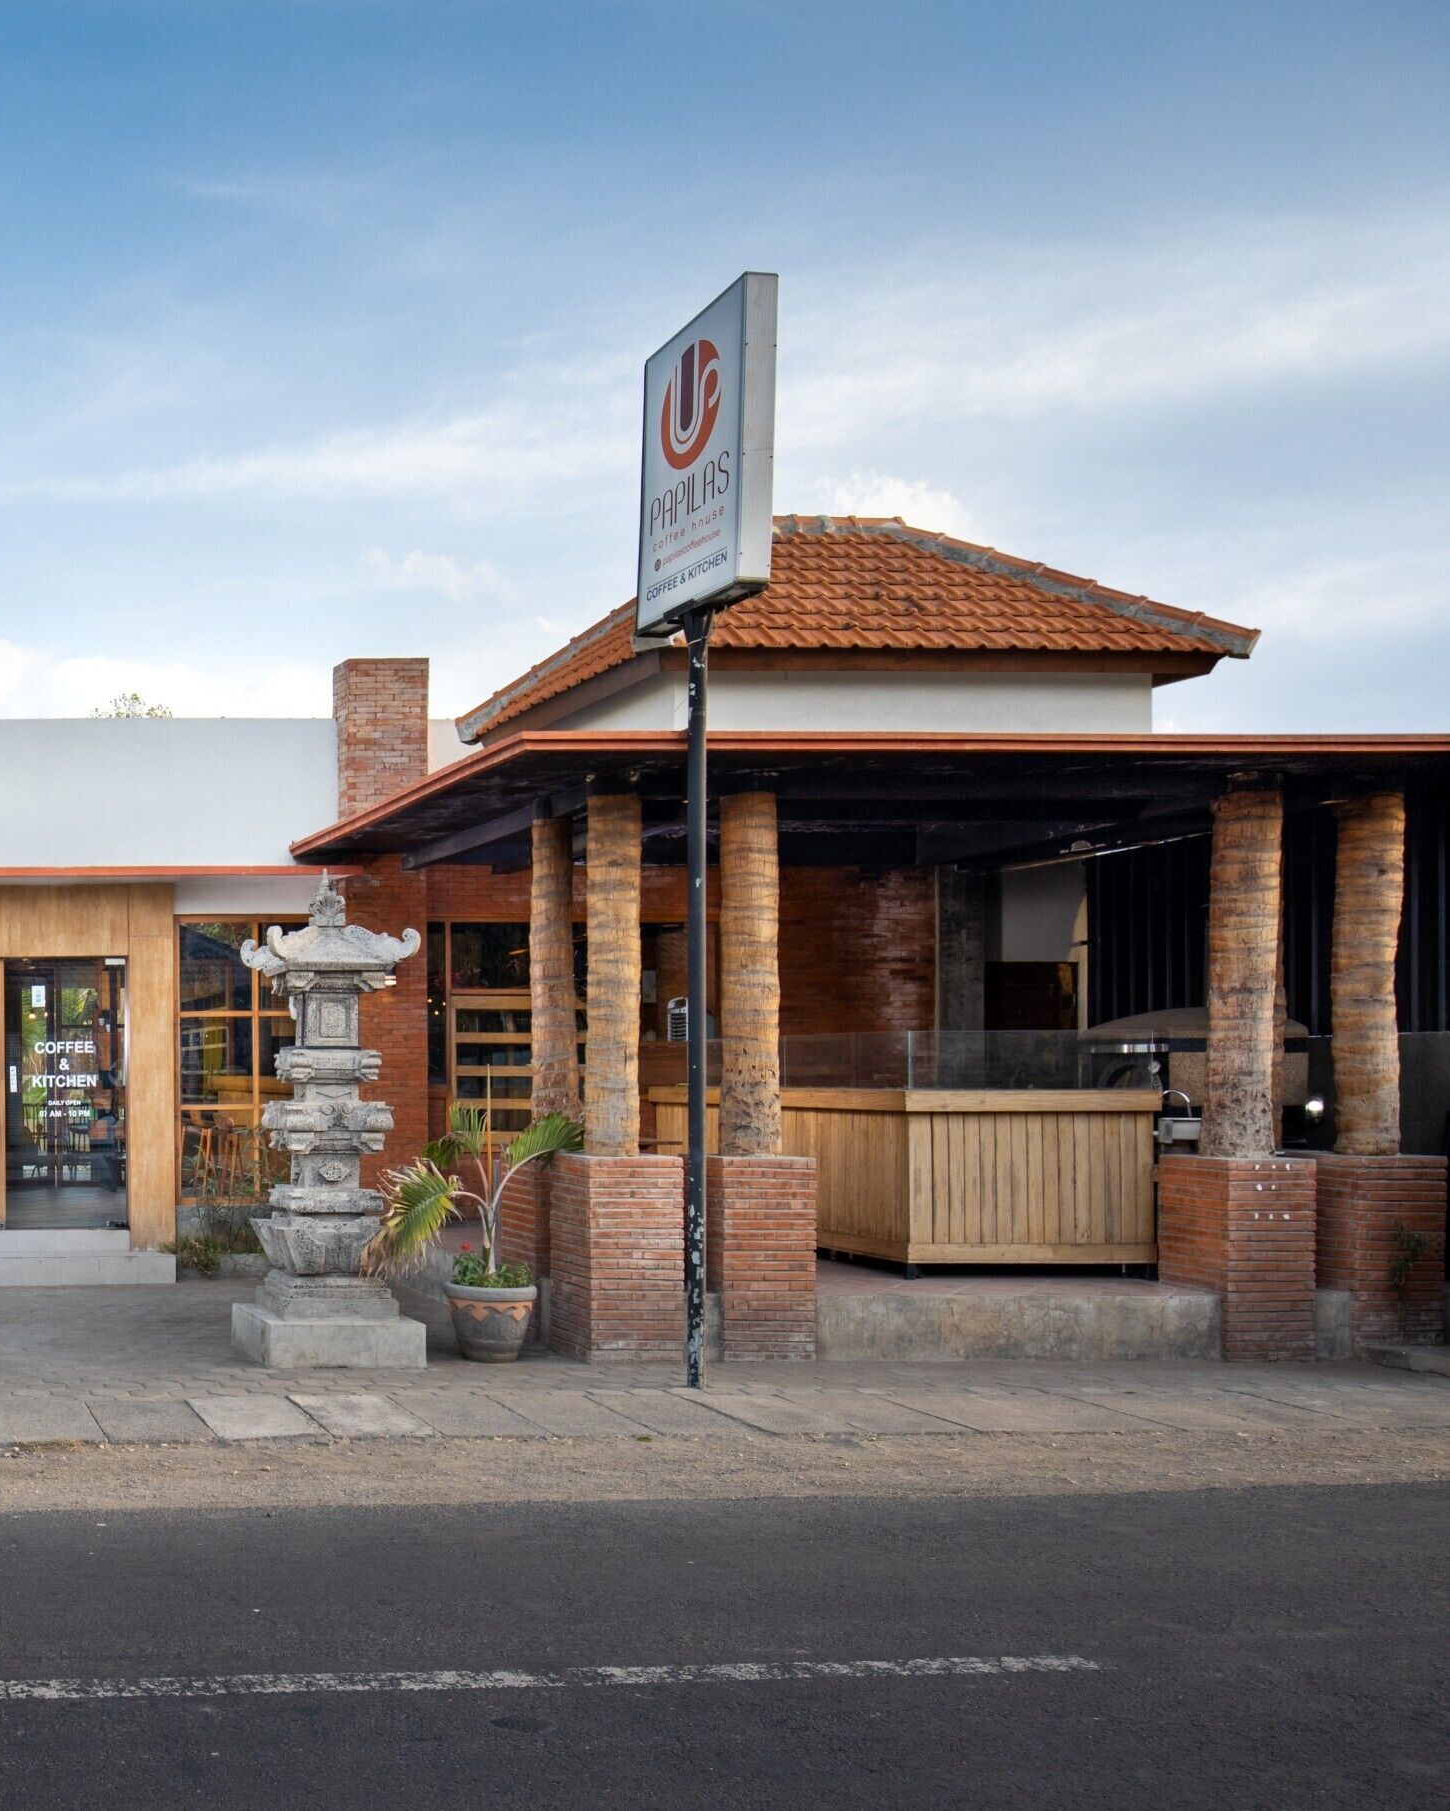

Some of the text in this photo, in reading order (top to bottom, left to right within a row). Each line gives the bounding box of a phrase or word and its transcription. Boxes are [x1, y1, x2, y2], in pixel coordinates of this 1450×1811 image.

[650, 450, 730, 536] PAPILAS
[652, 528, 686, 553] coffee
[646, 549, 729, 602] COFFEE & KITCHEN
[34, 1041, 94, 1054] COFFEE
[59, 1058, 70, 1071] &
[32, 1074, 97, 1087] KITCHEN
